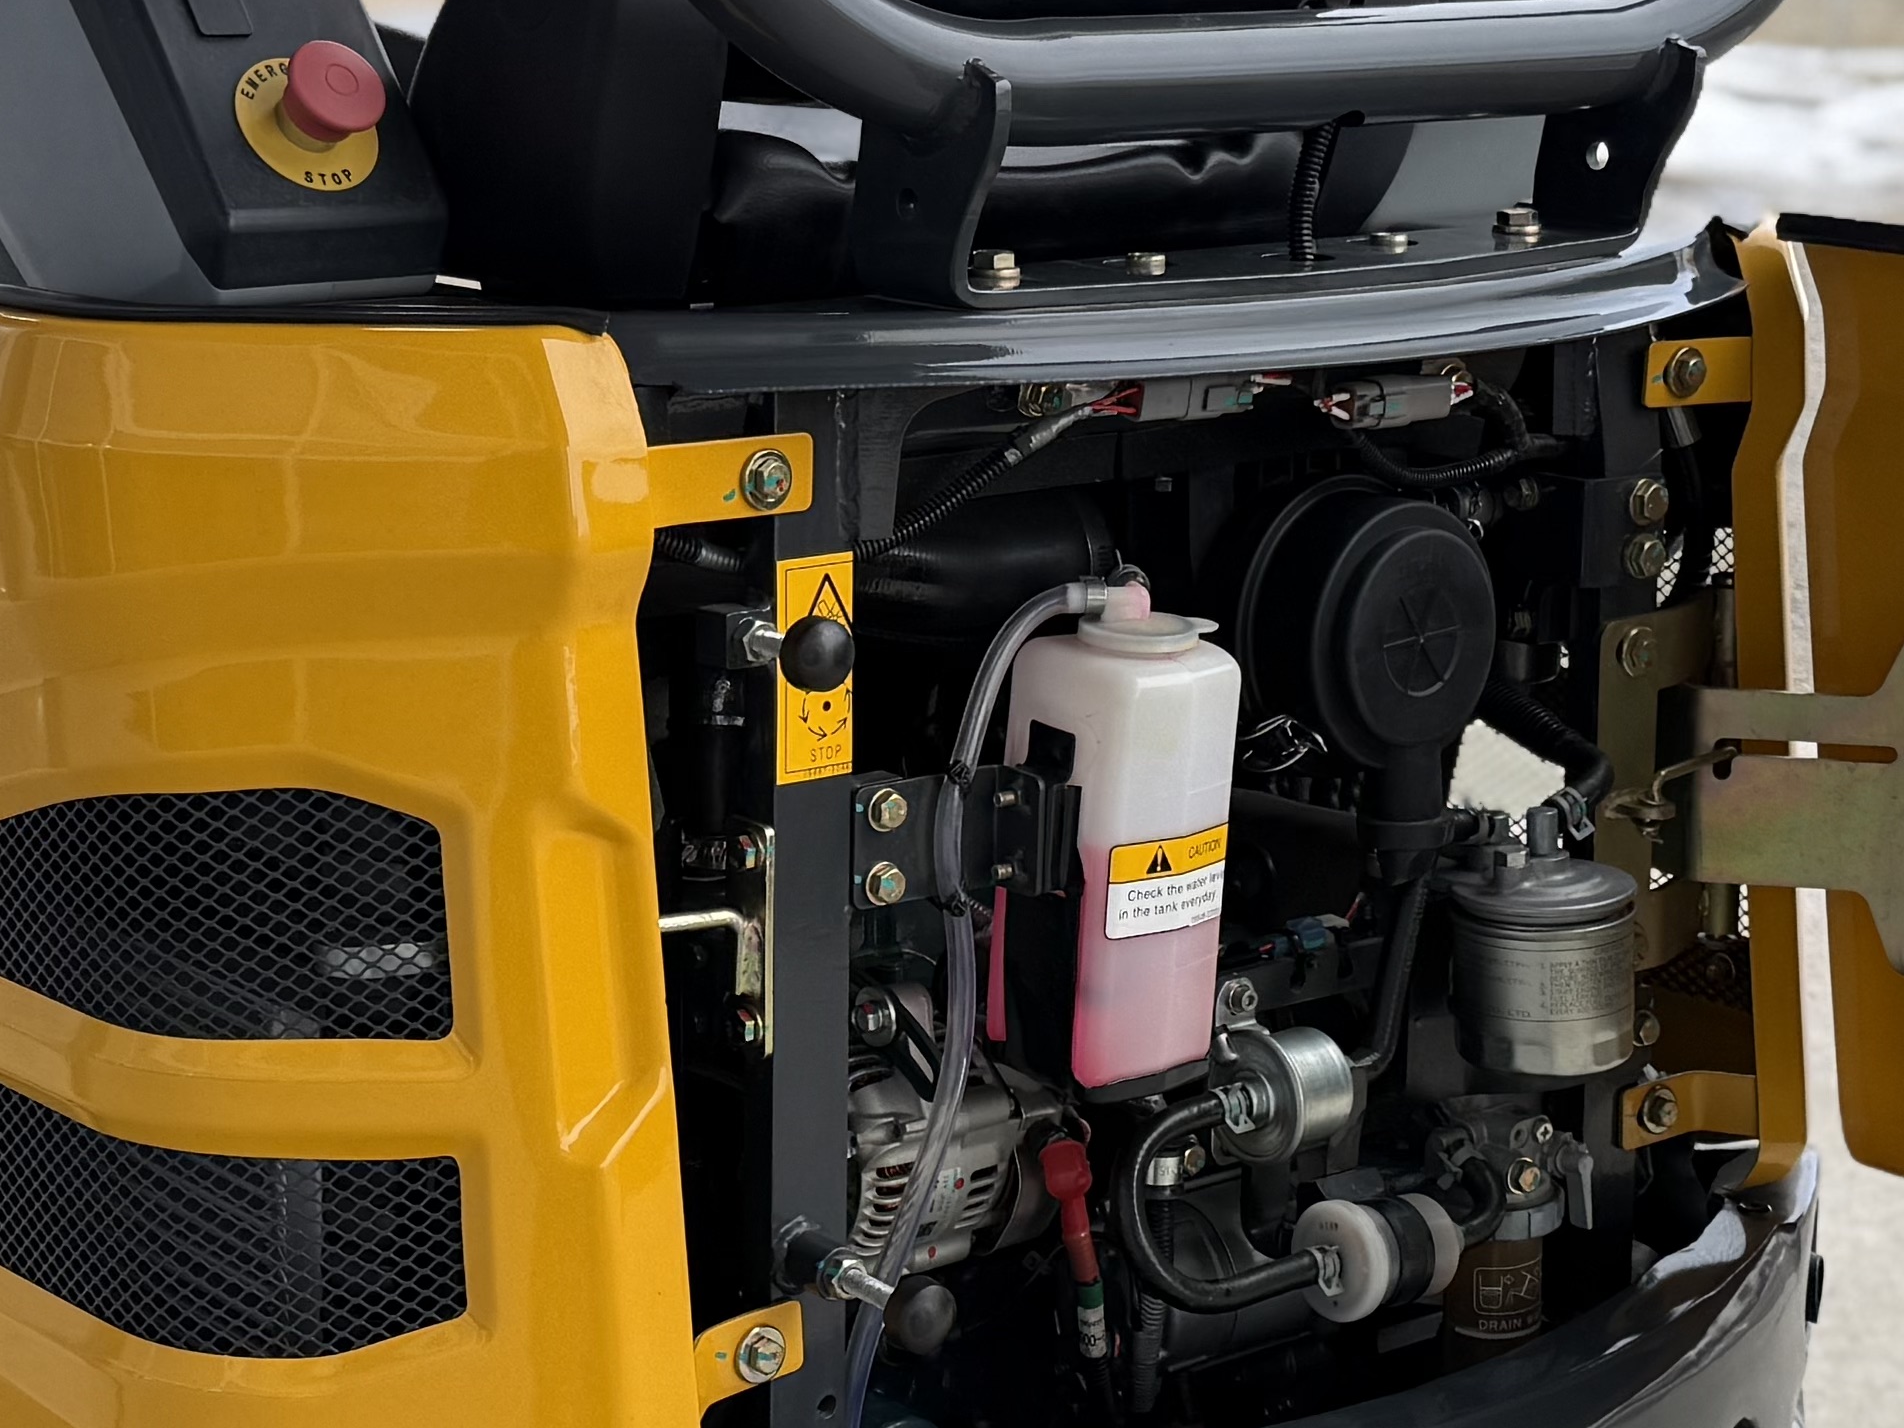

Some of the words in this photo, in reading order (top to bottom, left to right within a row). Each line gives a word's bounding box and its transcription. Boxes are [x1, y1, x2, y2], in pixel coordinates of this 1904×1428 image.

[303, 168, 353, 187] STOP
[810, 744, 842, 763] STOP
[1188, 837, 1222, 859] CAUTION
[1127, 885, 1163, 902] Check
[1167, 883, 1183, 897] the
[1118, 909, 1129, 921] in
[1132, 906, 1151, 918] the
[1154, 900, 1178, 916] tank
[1478, 1317, 1522, 1332] DRAIN
